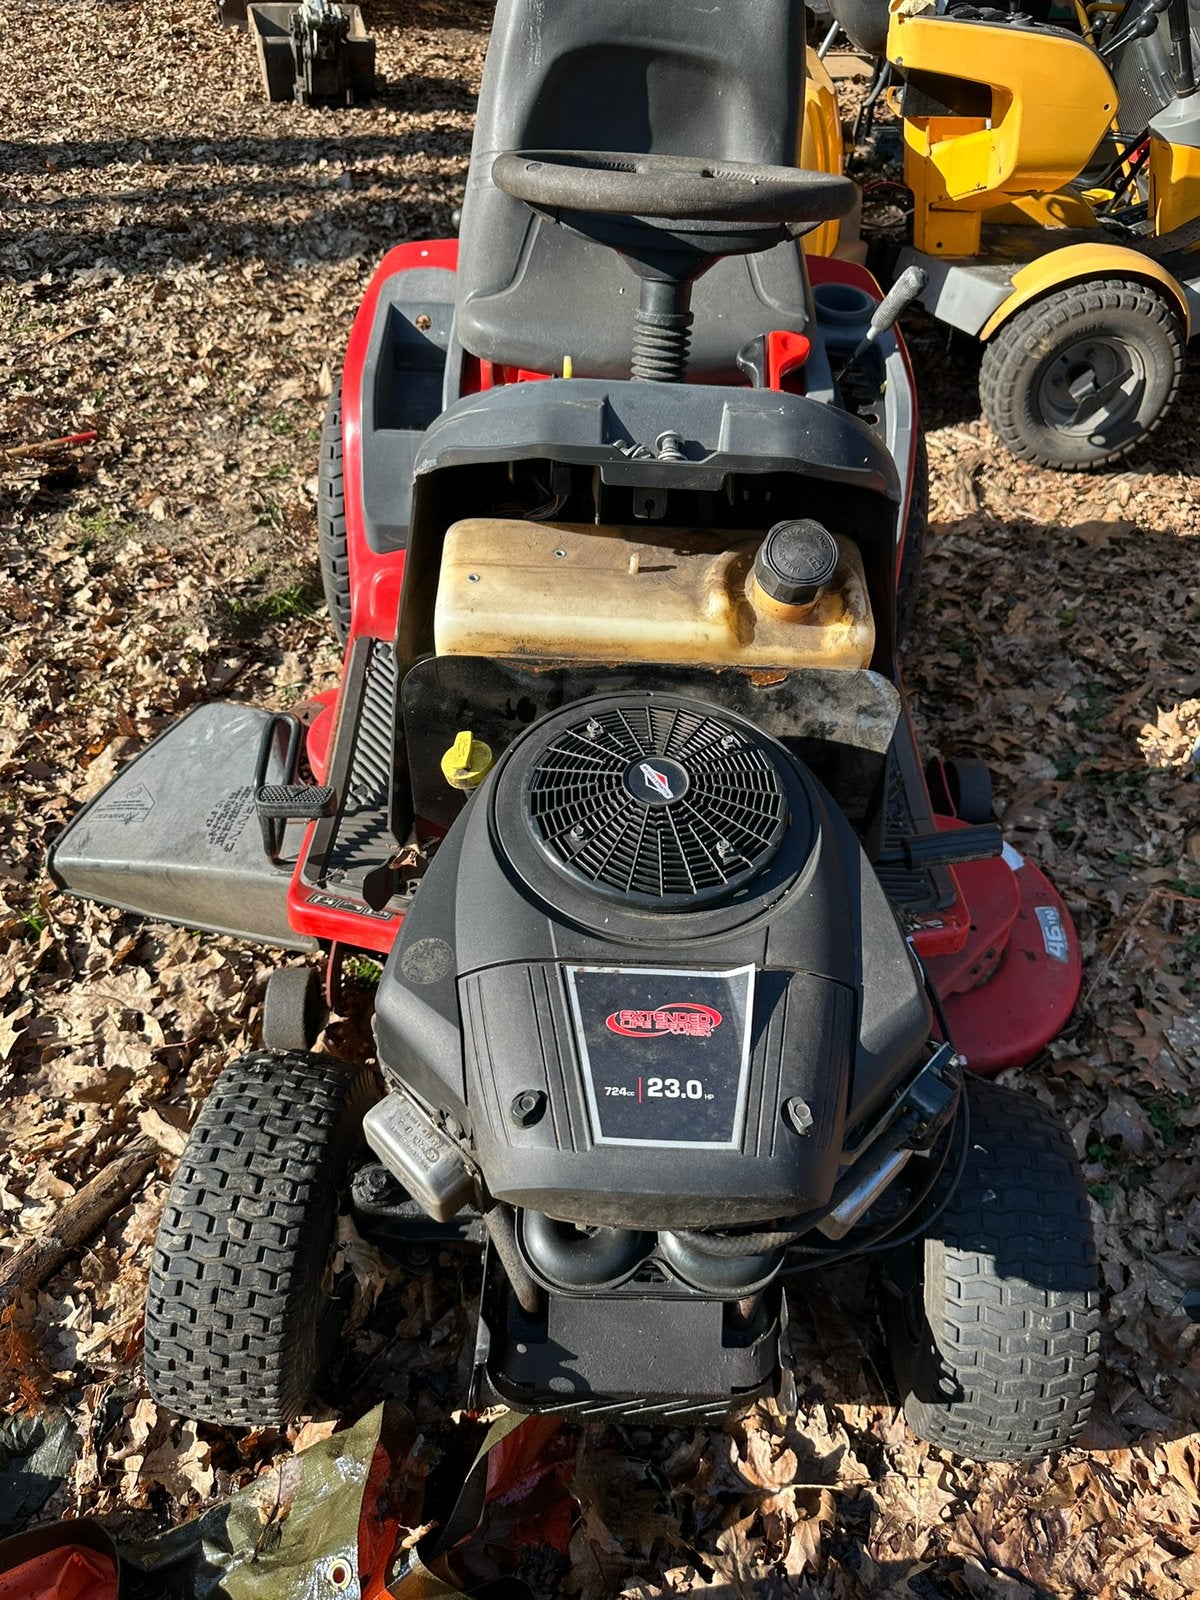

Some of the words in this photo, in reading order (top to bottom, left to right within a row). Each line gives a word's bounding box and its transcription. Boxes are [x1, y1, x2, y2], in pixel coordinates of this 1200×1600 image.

[620, 1010, 712, 1024] EXTENDED
[620, 1020, 652, 1029] LIFE
[656, 1021, 712, 1031] SERIES
[647, 1078, 702, 1099] 23.0
